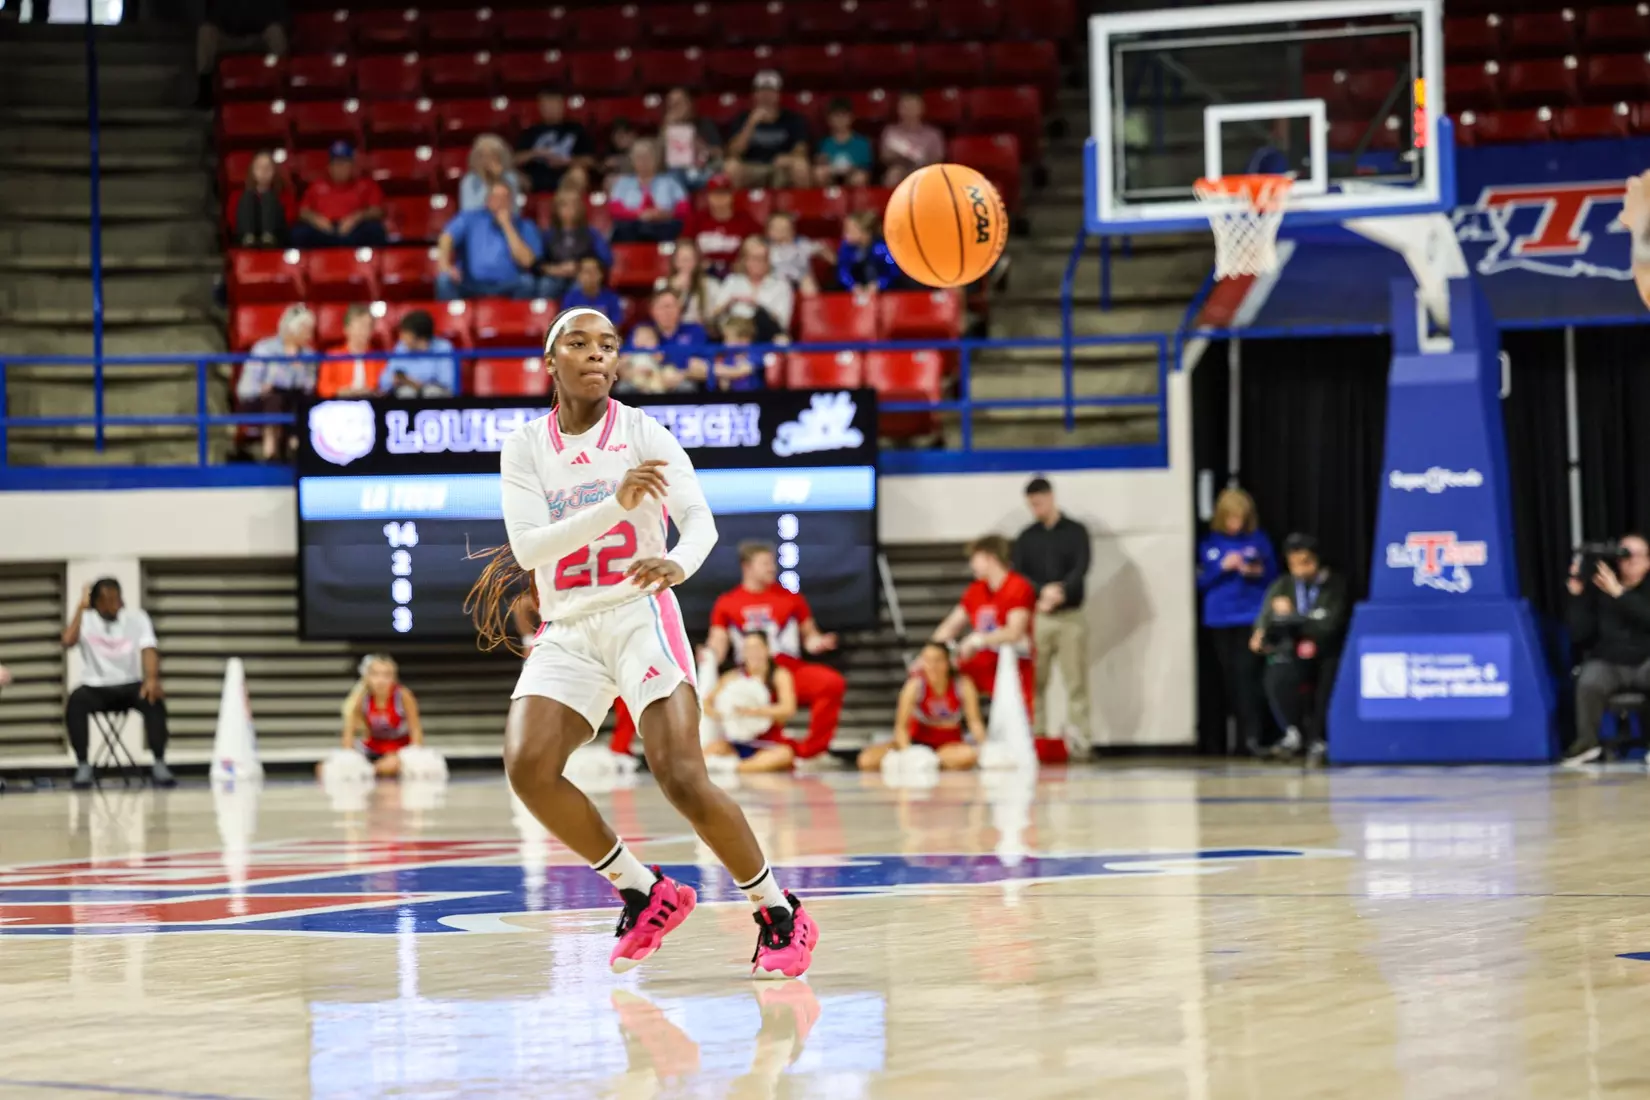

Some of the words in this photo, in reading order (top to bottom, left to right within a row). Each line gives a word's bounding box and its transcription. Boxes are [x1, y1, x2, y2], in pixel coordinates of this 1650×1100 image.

[965, 184, 990, 244] NCAA
[385, 408, 552, 453] LOUIS
[554, 520, 638, 591] 22
